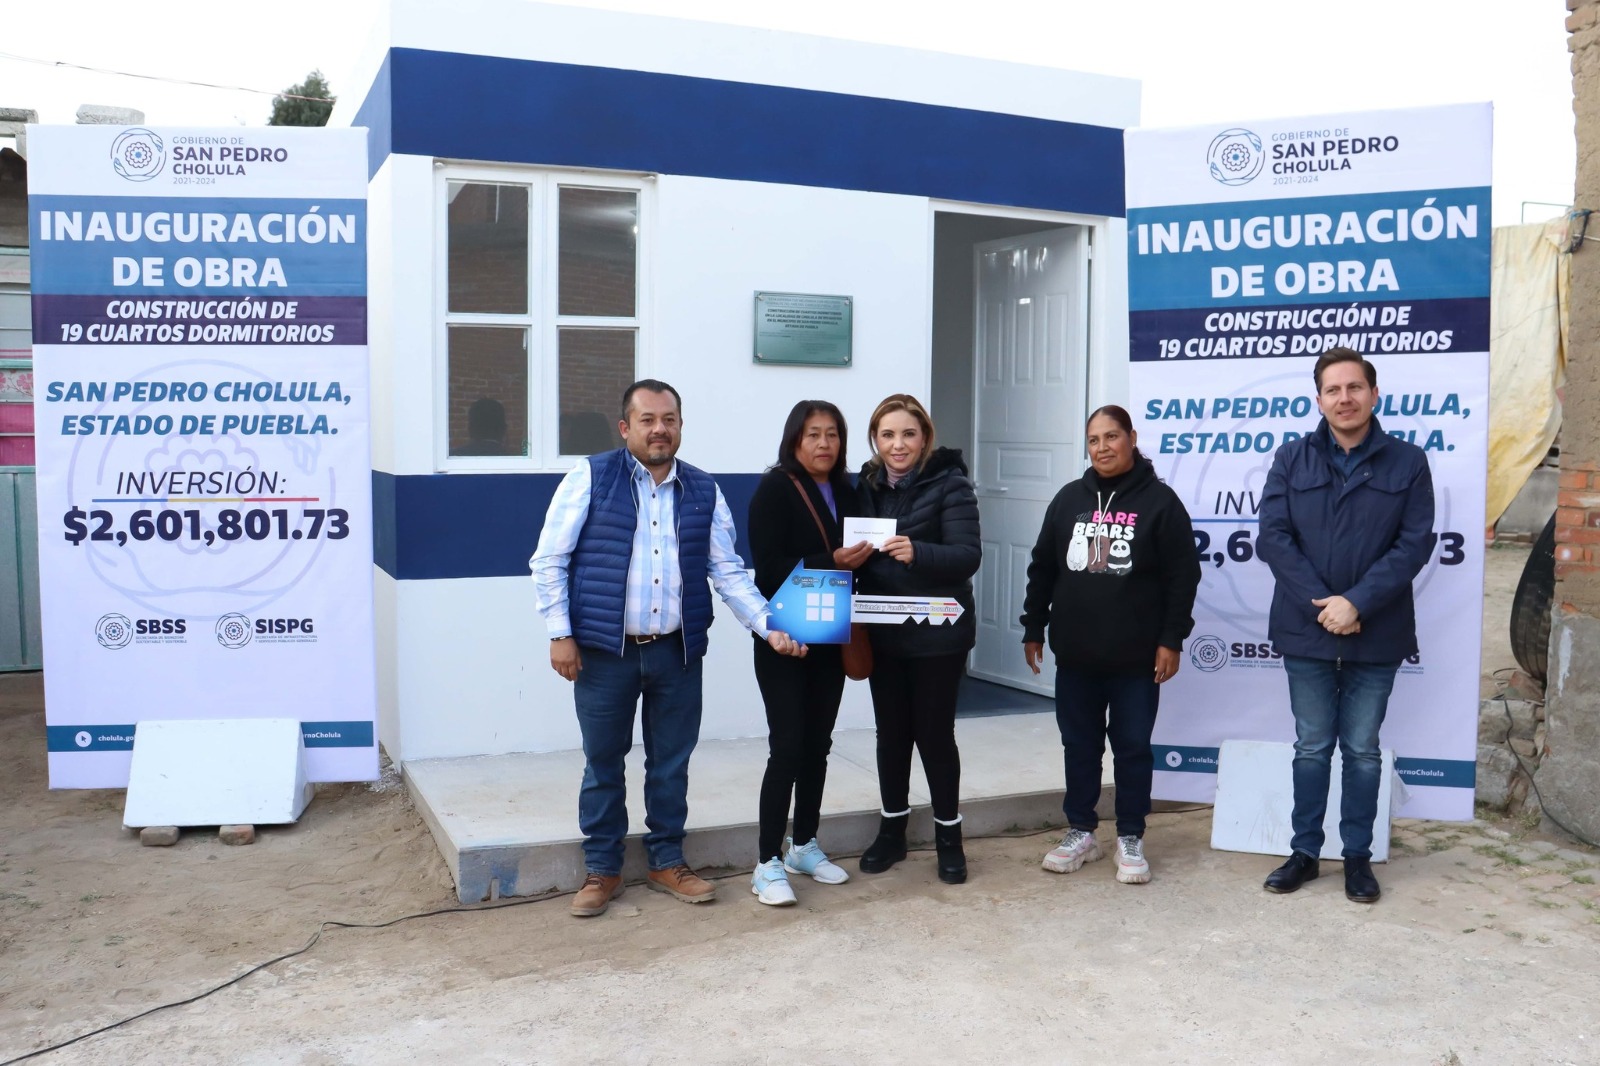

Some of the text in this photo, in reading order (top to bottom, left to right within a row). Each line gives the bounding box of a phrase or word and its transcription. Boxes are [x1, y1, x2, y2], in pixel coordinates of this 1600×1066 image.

[173, 136, 244, 145] GOBIERNO DE
[1272, 128, 1349, 142] GOBIERNO DE
[173, 146, 288, 163] SAN PEDRO
[1272, 135, 1399, 160] SAN PEDRO
[173, 163, 246, 176] CHOLULA
[1272, 157, 1352, 175] CHOLULA
[173, 177, 216, 185] 2021-2024
[1273, 175, 1319, 186] 2021-2024
[40, 205, 356, 244] INAUGURACIÓN
[1137, 197, 1478, 255] INAUGURACIÓN
[112, 256, 288, 288] DE OBRA
[1211, 258, 1400, 298] DE OBRA
[106, 296, 298, 319] CONSTRUCCIÓN DE
[1204, 302, 1411, 332] CONSTRUCCIÓN DE
[61, 323, 335, 343] 19 CUARTOS DORMITORIOS
[1159, 330, 1453, 358] 19 CUARTOS DORMITORIOS
[46, 381, 352, 406] SAN PEDRO CHOLULA,
[1145, 398, 1209, 420] SAN
[1211, 396, 1311, 418] PEDRO
[61, 414, 339, 436] ESTADO DE PUEBLA.
[1159, 431, 1275, 454] ESTADO
[116, 465, 287, 495] INVERSIÓN:
[63, 505, 350, 547] $2,601,801.73
[1092, 510, 1138, 526] BARE
[1073, 522, 1135, 541] BEARS
[136, 618, 186, 634] SBSS
[255, 618, 314, 634] SISPG
[98, 735, 135, 743] cholula.go
[1188, 756, 1218, 765] cholula.
